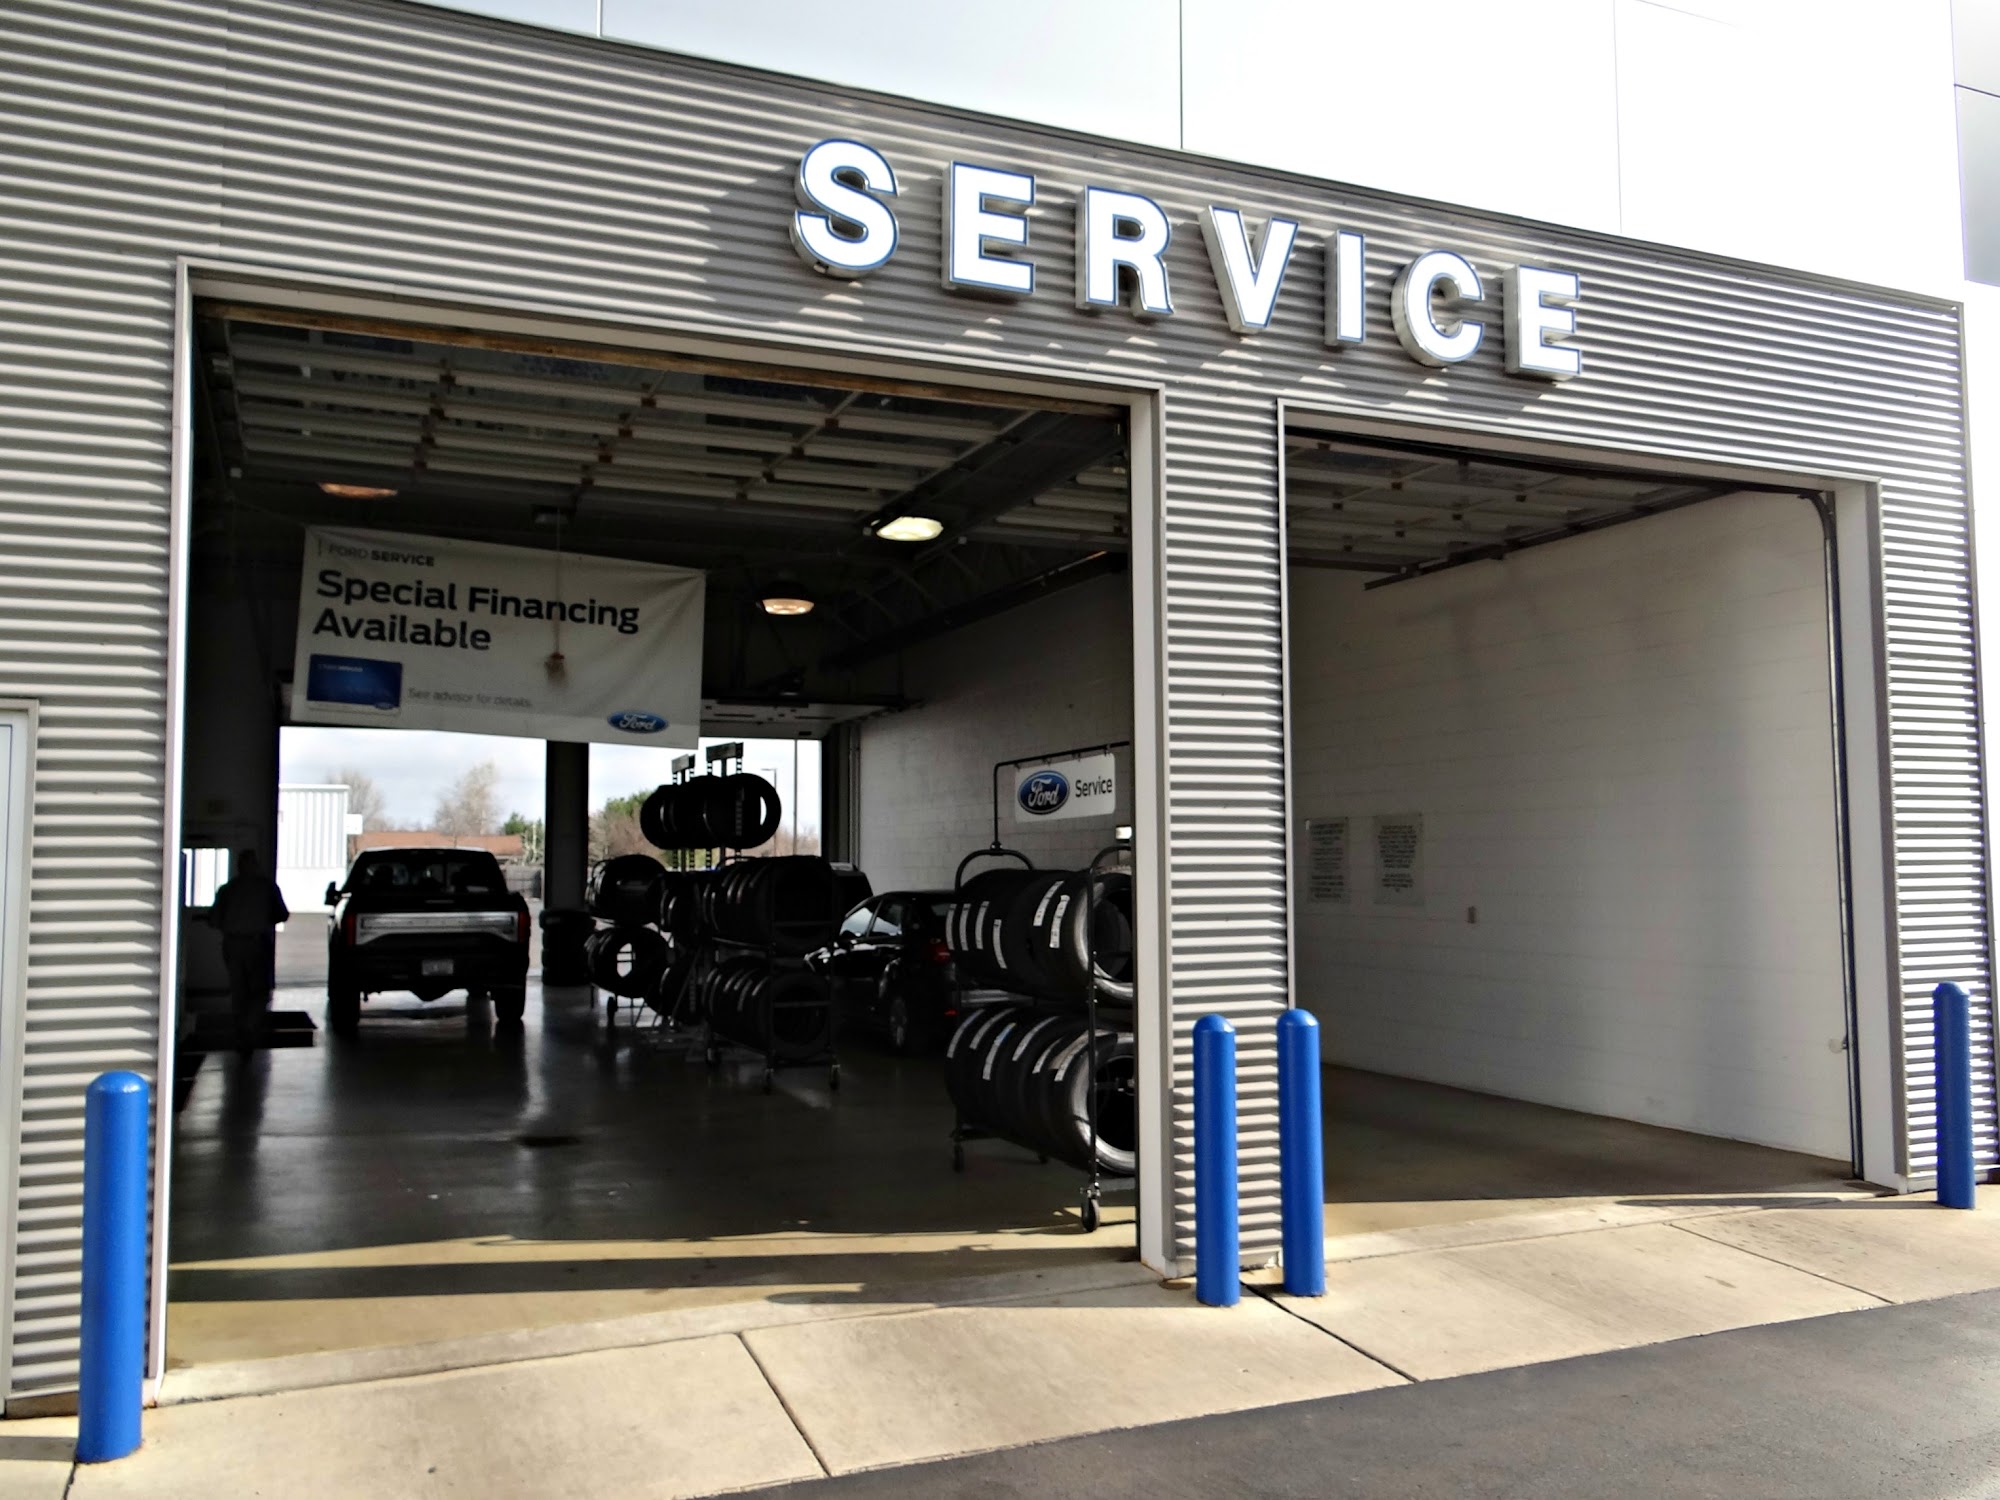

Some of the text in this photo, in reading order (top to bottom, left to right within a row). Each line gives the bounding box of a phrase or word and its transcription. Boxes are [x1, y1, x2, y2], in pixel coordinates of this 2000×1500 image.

[789, 137, 1583, 381] SERVICE
[371, 550, 435, 566] SERVICE
[316, 569, 640, 634] Special Financing
[312, 607, 492, 651] Available
[432, 690, 473, 703] advisor
[617, 713, 658, 733] Ford
[1027, 776, 1113, 807] Ford Service
